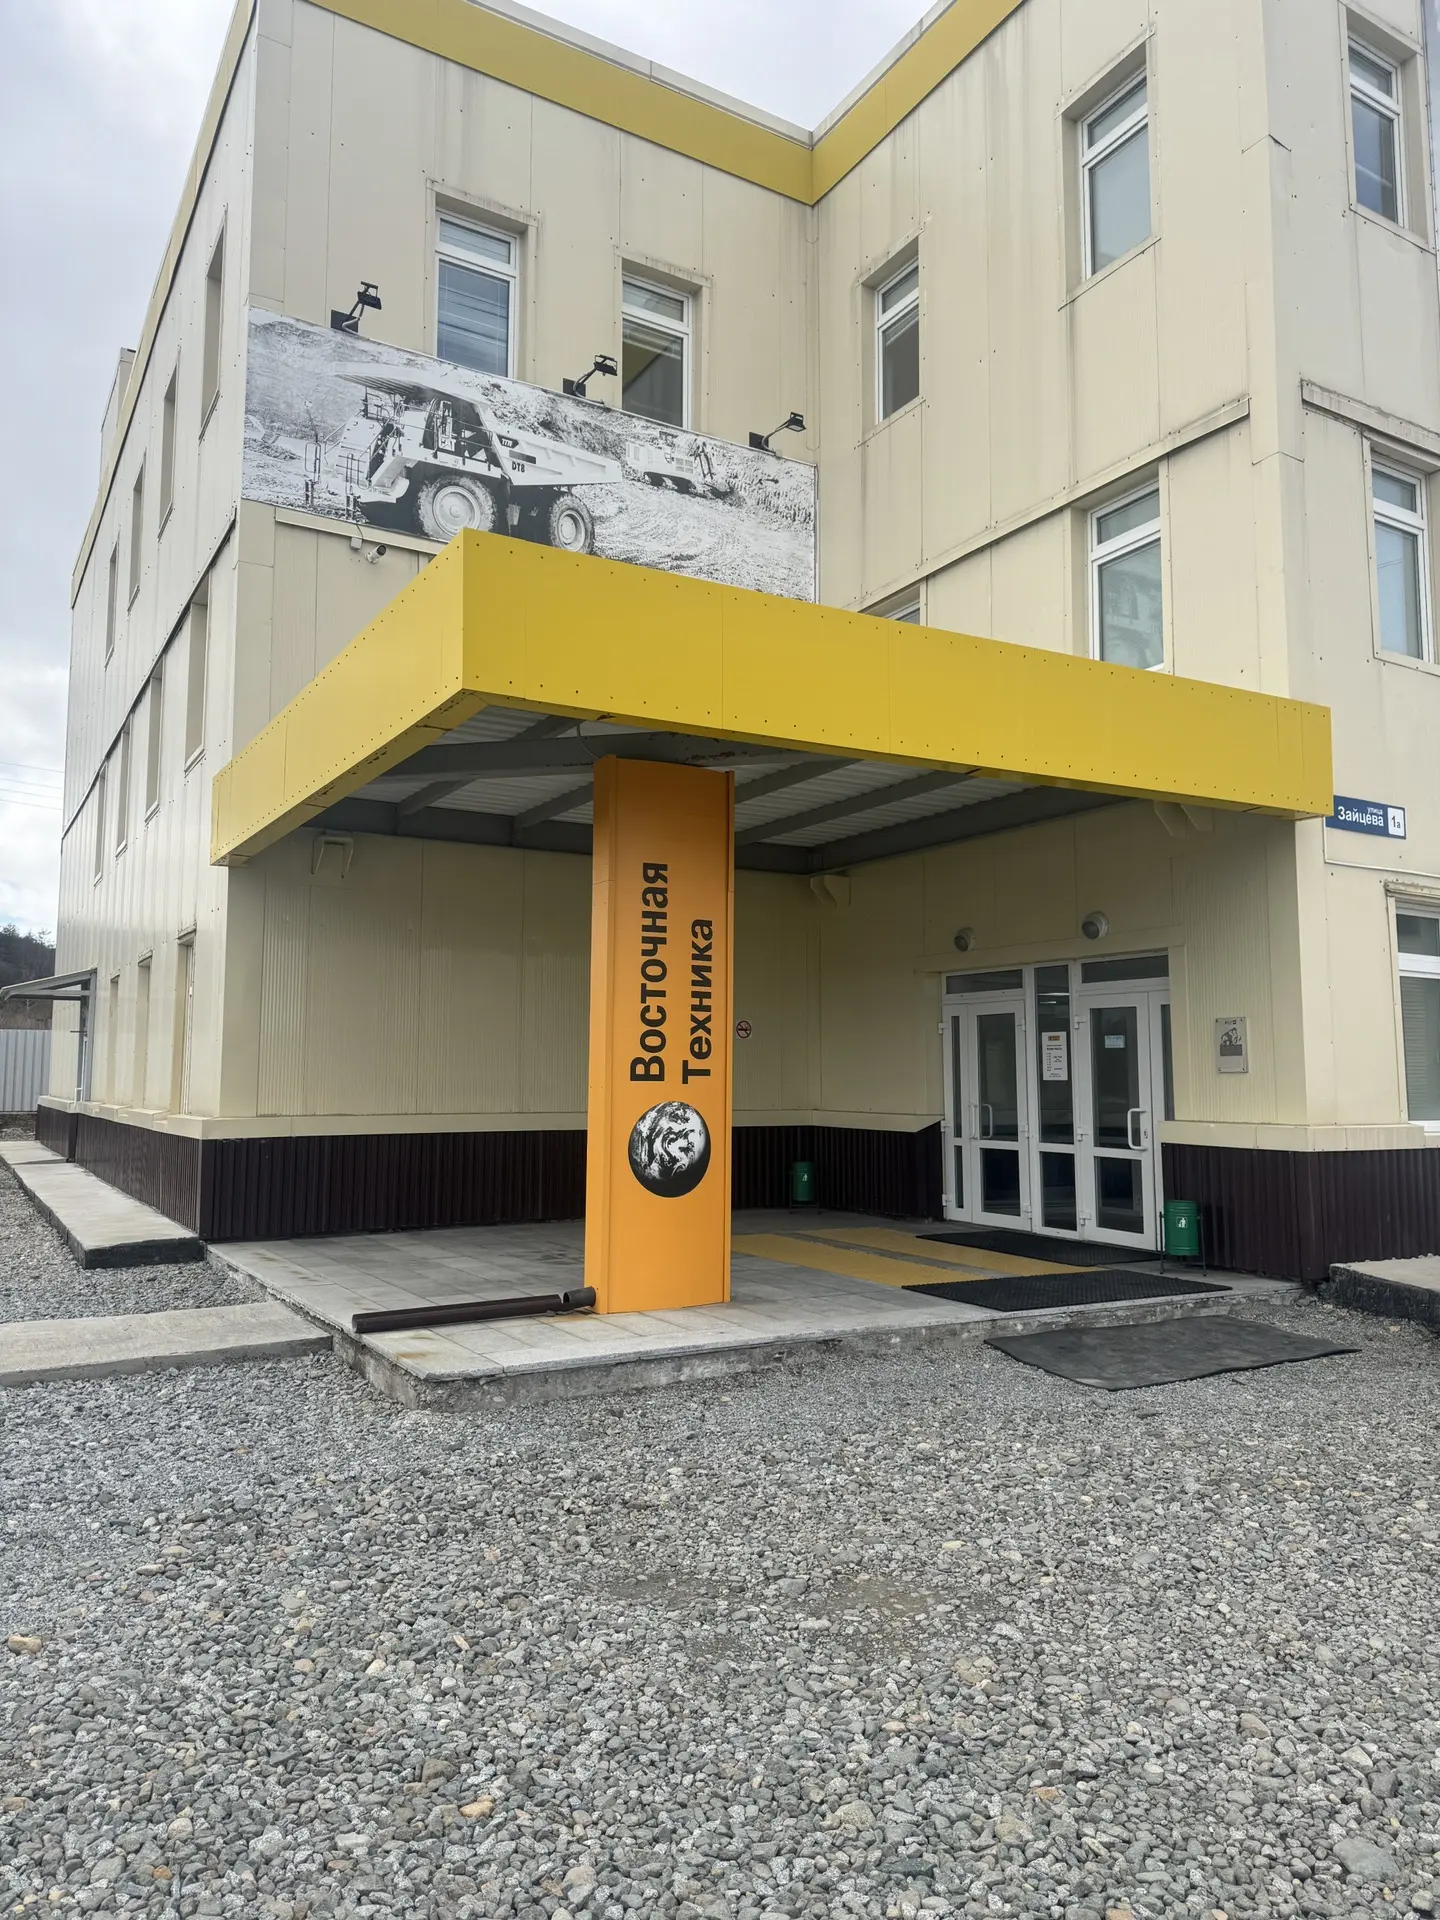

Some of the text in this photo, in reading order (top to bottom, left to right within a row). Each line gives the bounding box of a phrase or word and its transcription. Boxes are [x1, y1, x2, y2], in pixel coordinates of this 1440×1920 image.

[512, 461, 525, 473] DT8
[1337, 805, 1384, 827] Зайцева
[1391, 815, 1401, 829] 1а
[629, 862, 669, 1082] Восточная
[681, 918, 713, 1084] Техника
